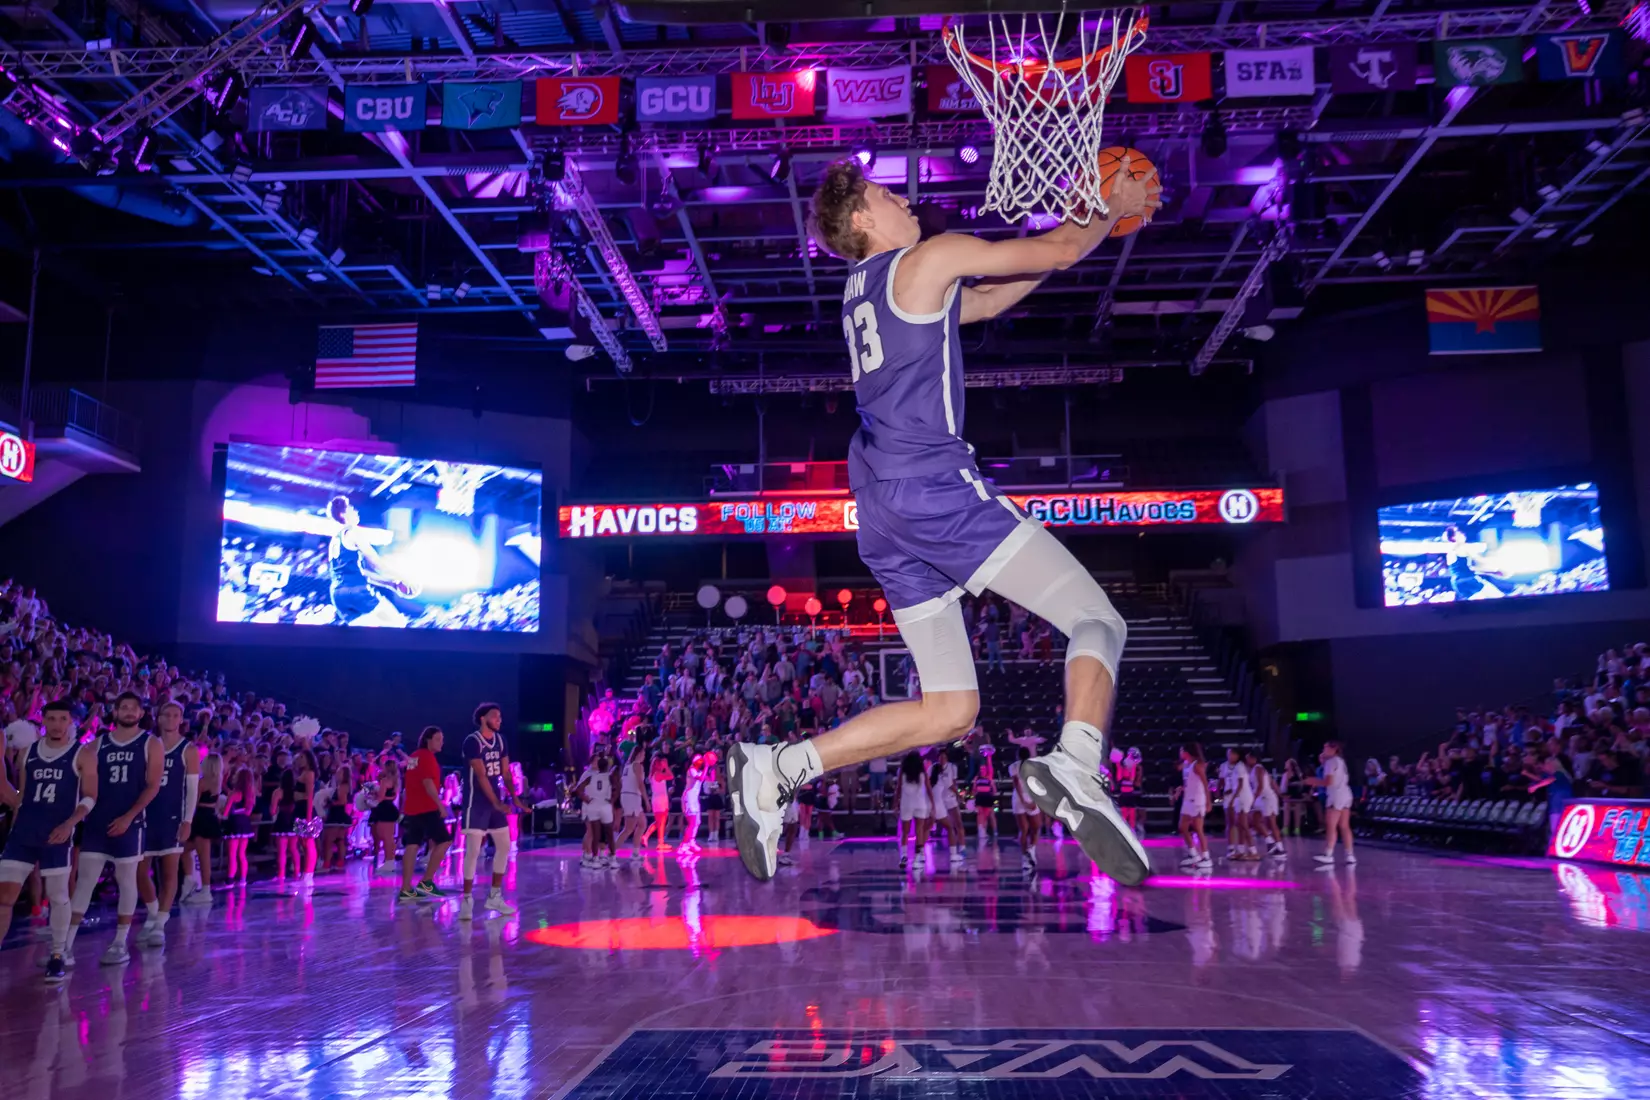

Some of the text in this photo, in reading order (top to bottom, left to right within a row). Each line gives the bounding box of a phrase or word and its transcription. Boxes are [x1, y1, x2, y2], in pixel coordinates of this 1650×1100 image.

[833, 75, 905, 102] WAC
[356, 96, 413, 120] CBU
[641, 86, 711, 115] GCU
[266, 103, 307, 126] ACU
[567, 506, 697, 537] HAVOCS
[721, 502, 817, 521] FOLLOW
[106, 751, 134, 762] GCU
[33, 767, 64, 780] GCU
[109, 764, 129, 783] 31
[486, 761, 501, 776] 35
[33, 782, 57, 803] 14
[706, 1038, 1296, 1080] WAC
